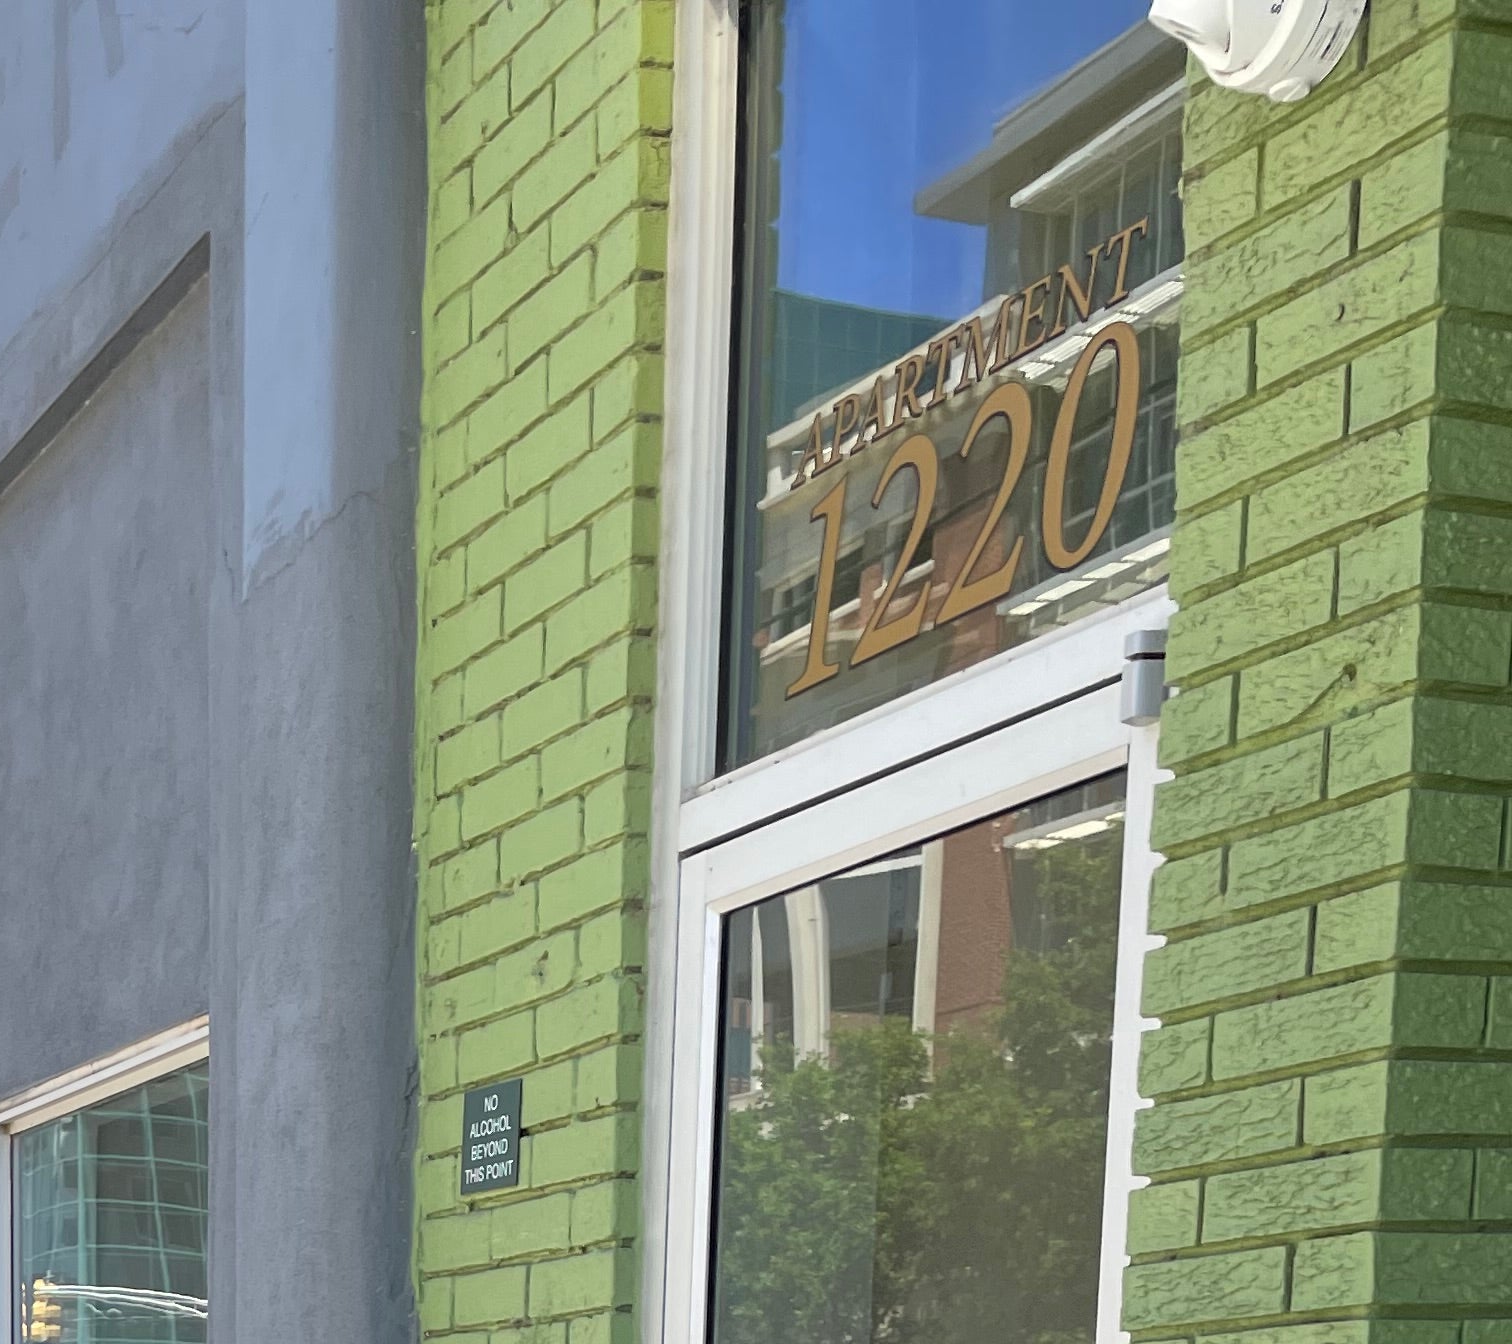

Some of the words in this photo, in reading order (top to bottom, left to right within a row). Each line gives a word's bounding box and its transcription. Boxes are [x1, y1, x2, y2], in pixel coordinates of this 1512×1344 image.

[790, 216, 1148, 490] APARTMENT
[785, 322, 1141, 700] 1220
[484, 1094, 498, 1112] NO
[469, 1115, 511, 1138] ALCOHOL
[471, 1138, 508, 1161] BEYOND
[465, 1165, 485, 1185] THIS
[486, 1160, 513, 1180] POINT
